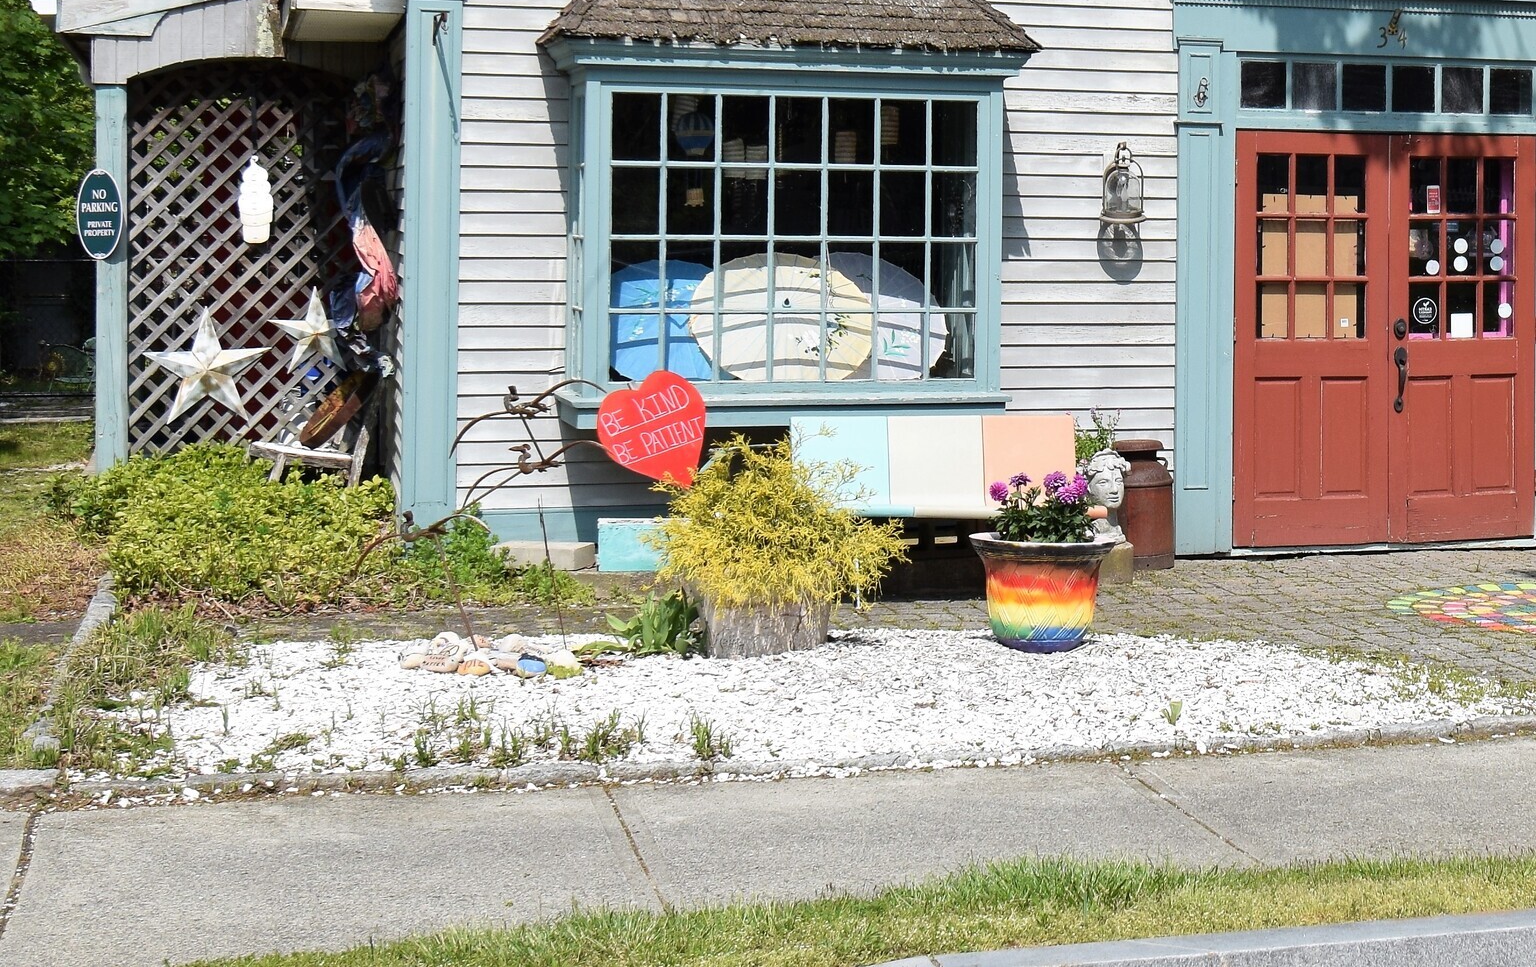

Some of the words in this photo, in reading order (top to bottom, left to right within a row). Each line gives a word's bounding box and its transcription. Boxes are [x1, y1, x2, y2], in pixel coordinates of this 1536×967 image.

[92, 189, 107, 200] NO
[81, 201, 118, 213] PARKING
[87, 220, 113, 228] PRIVATE
[84, 229, 116, 237] PROPERTY
[600, 408, 629, 437] BE
[632, 384, 690, 423] KIND
[612, 439, 638, 464] BE
[639, 416, 703, 455] PATIENT
